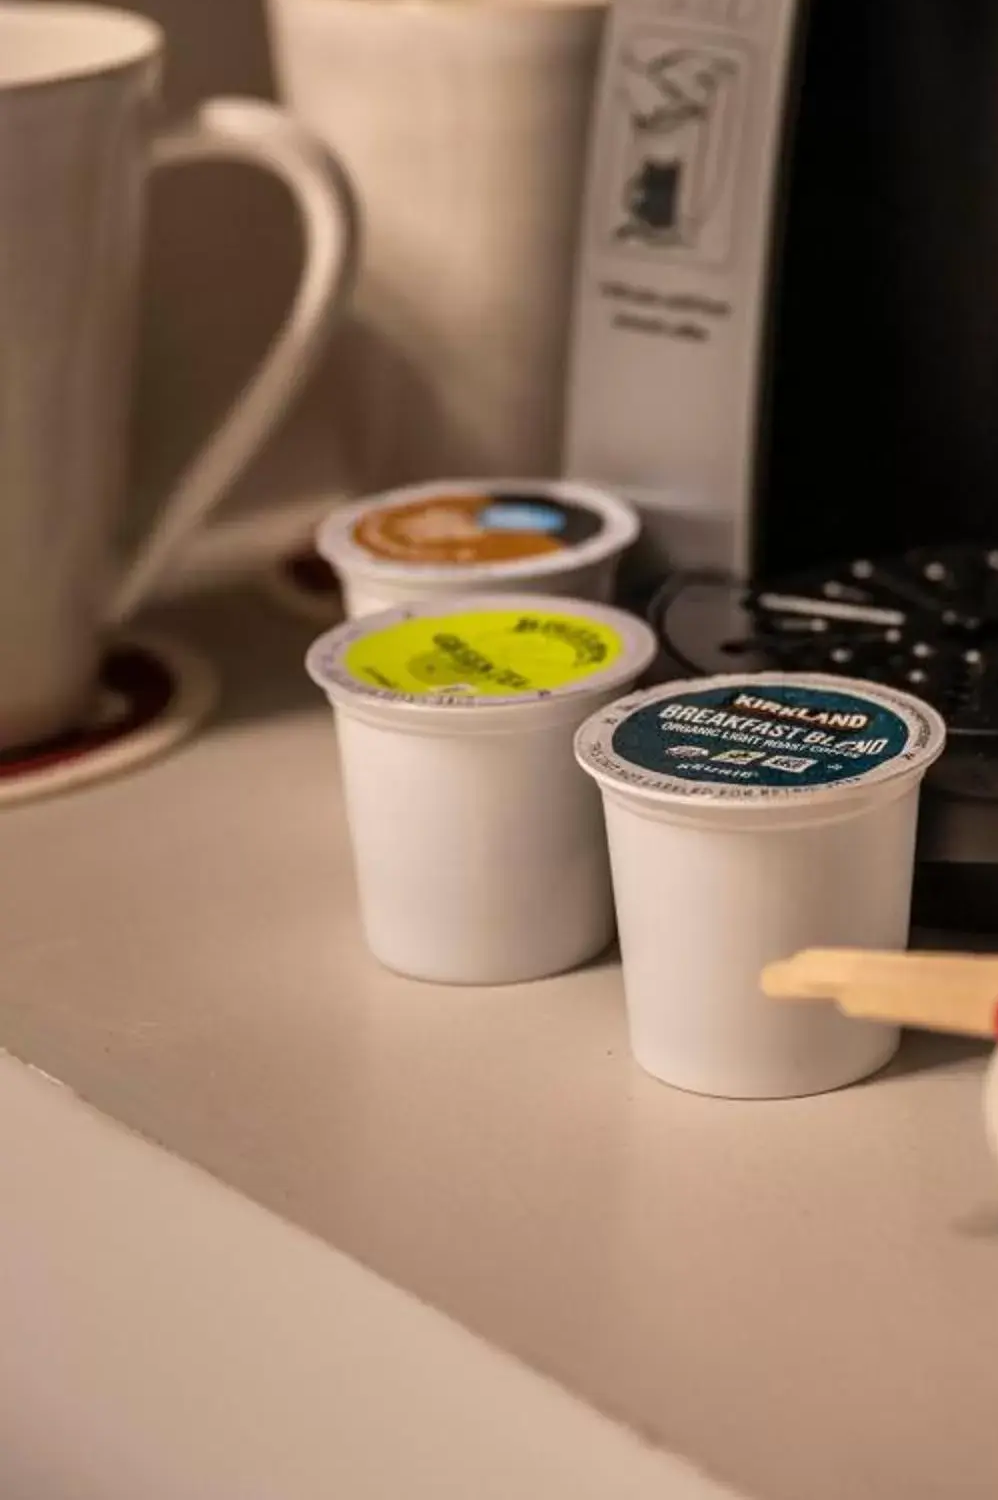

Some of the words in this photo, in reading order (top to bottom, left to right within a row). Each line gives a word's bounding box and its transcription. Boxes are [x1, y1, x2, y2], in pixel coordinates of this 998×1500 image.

[733, 694, 868, 729] KIRKLAND
[659, 704, 805, 739] BREAKFAST
[803, 730, 889, 755] BLEND
[661, 722, 721, 737] ORGANIC
[721, 730, 763, 746] LIGHT
